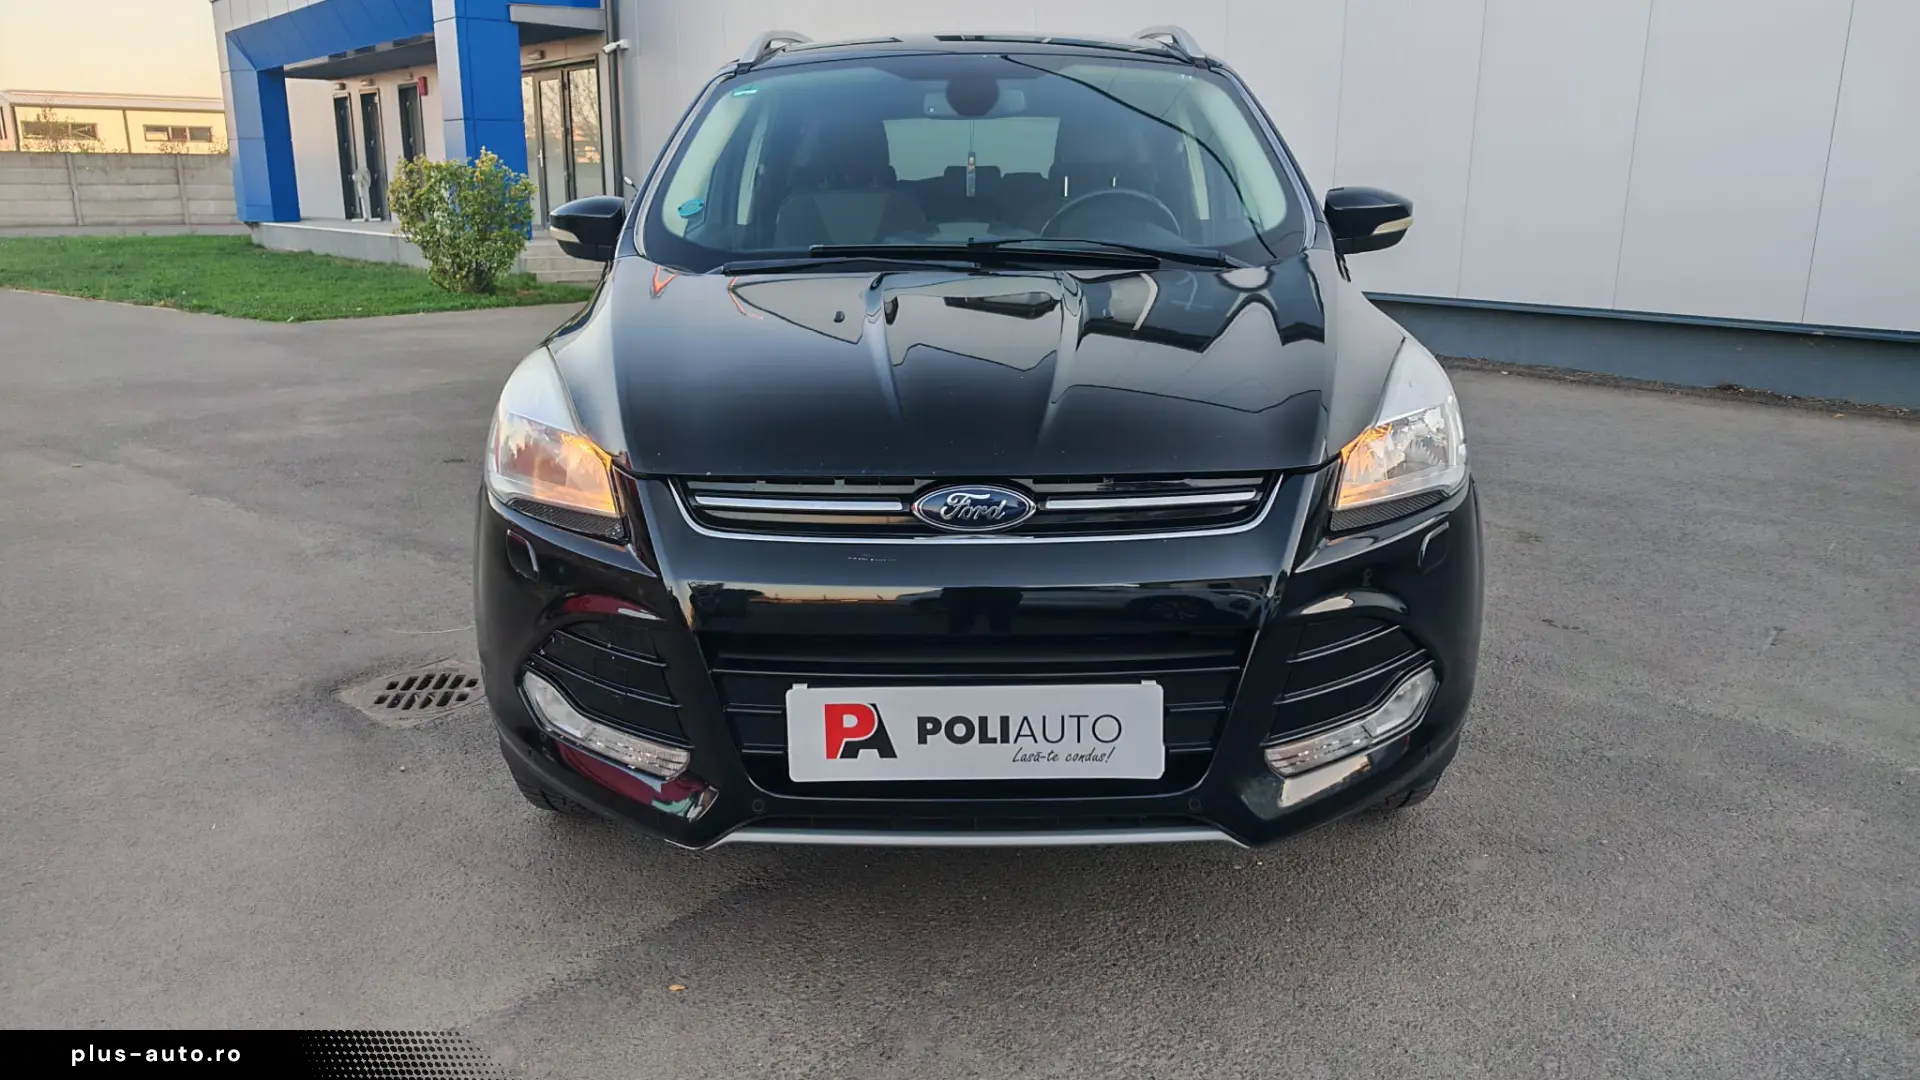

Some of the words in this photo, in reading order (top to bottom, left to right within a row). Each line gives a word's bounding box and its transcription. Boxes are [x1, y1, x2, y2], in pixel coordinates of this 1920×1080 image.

[939, 492, 1007, 521] Ford
[917, 714, 1122, 745] POLIAUTO
[1065, 746, 1115, 763] condus!
